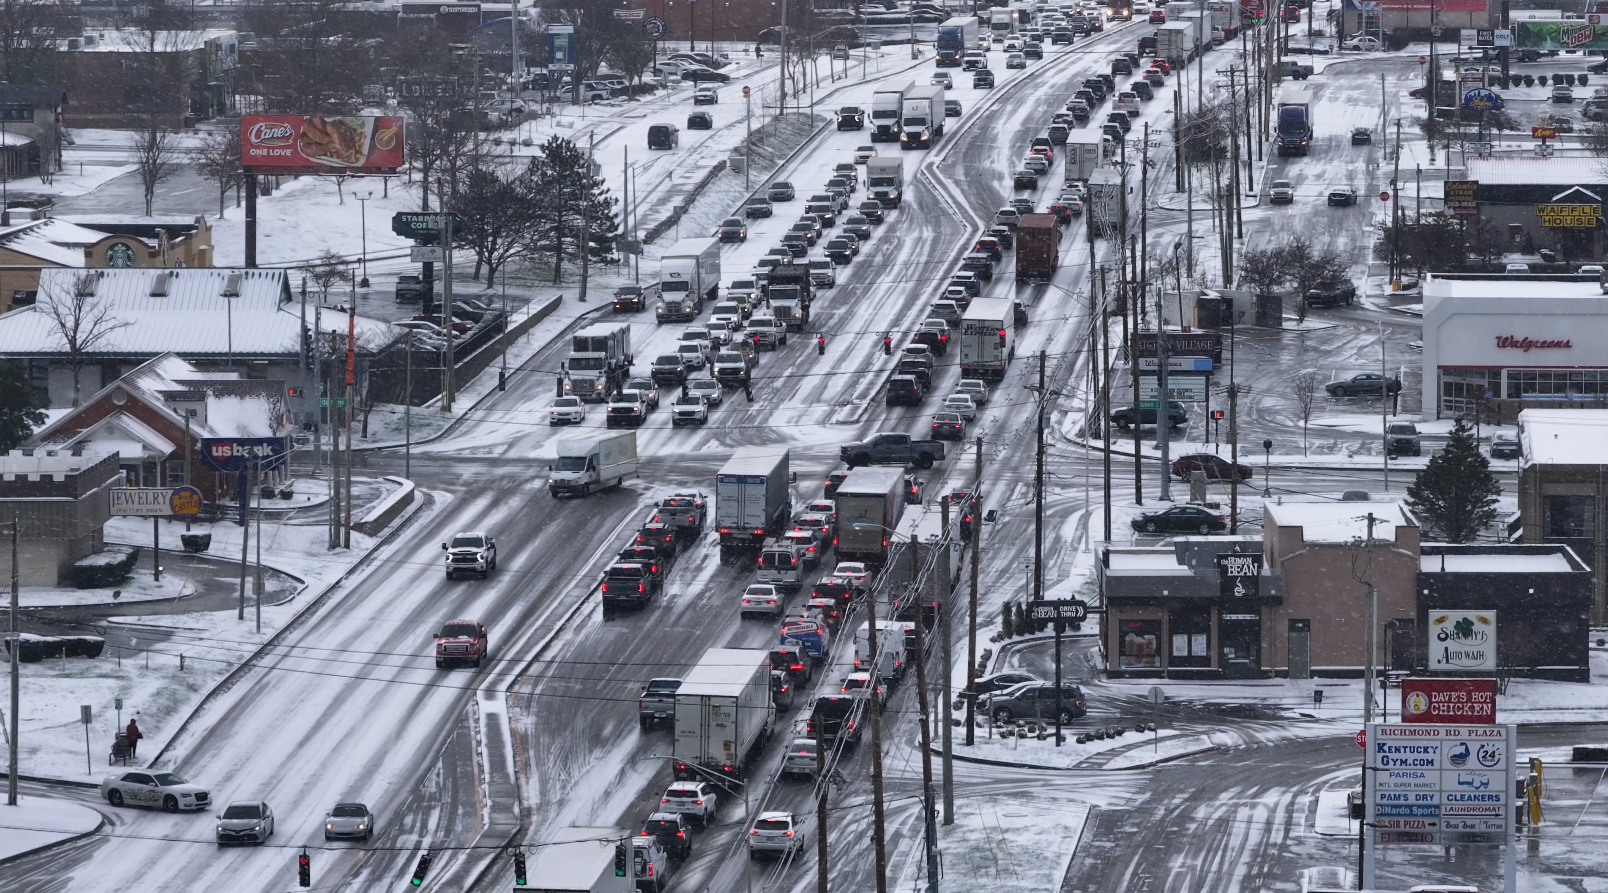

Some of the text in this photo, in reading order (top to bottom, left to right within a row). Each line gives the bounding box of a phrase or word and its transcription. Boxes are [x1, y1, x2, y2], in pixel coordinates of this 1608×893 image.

[250, 122, 292, 143] Cane's
[1537, 206, 1601, 214] WAFFLE
[1542, 217, 1596, 226] HOUSE
[1176, 340, 1213, 350] VILLAGE
[1495, 334, 1572, 352] Walgreens
[112, 492, 168, 507] JEWELRY
[174, 503, 198, 513] CASTLE
[1227, 563, 1258, 576] BEAN
[1039, 610, 1057, 618] BEAN
[1432, 692, 1492, 702] DAVE'S HOT
[1431, 704, 1492, 715] CHICKEN
[1380, 728, 1440, 736] RICHMOND
[1377, 743, 1439, 754] KENTUCKY
[1482, 750, 1496, 758] 24
[1446, 794, 1501, 802] CLEANERS
[1376, 806, 1439, 815] DiNardo Sports
[1388, 820, 1426, 828] SIR PIZZA
